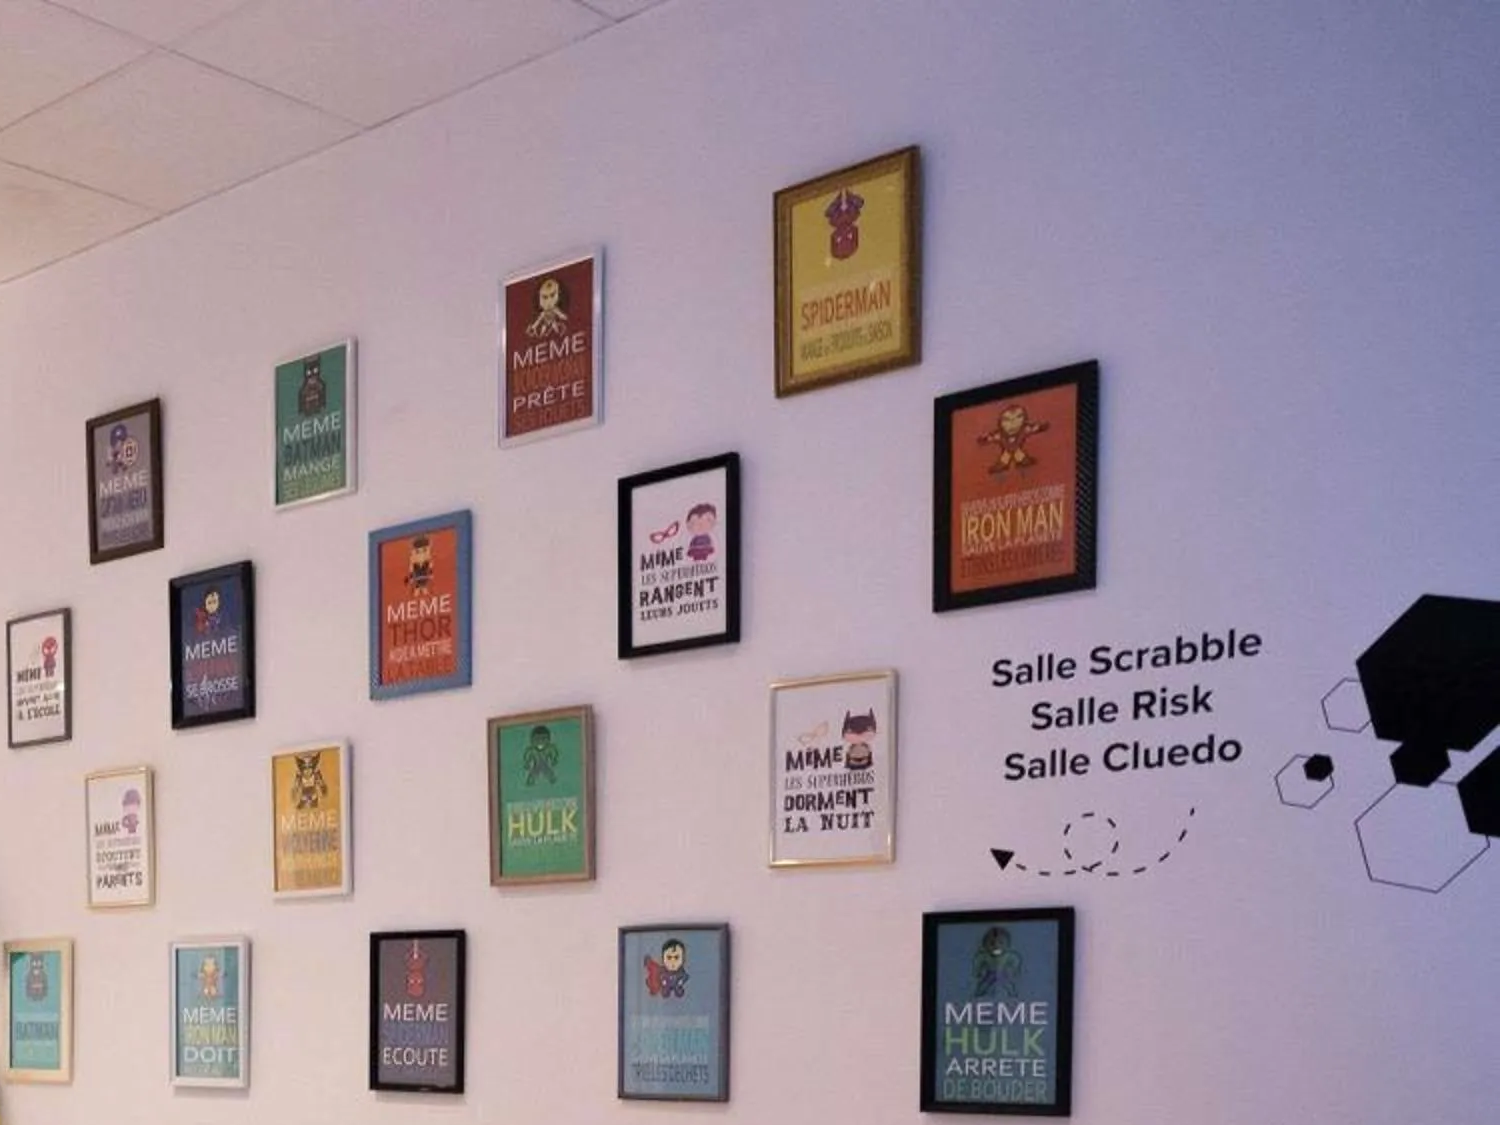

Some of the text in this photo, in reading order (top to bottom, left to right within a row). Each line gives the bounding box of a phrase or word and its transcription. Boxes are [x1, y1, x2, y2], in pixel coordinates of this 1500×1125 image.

[801, 280, 892, 331] SPIDERMAN
[512, 332, 587, 369] MEME
[512, 380, 586, 413] PRÊTE
[283, 411, 342, 445] MEME
[99, 470, 150, 499] MEME
[961, 509, 1011, 551] IRON
[1018, 498, 1064, 537] MAN
[639, 576, 719, 608] RANGENT
[387, 594, 453, 623] MEME
[677, 598, 719, 616] JOUETS
[389, 616, 453, 647] THOR
[185, 635, 239, 661] MEME
[991, 628, 1263, 687] Salle Scrabble
[1031, 685, 1214, 730] Salle Risk
[1004, 734, 1243, 781] Salle Cluedo
[783, 788, 875, 812] DORMENT
[281, 809, 337, 835] MEME
[508, 806, 578, 841] HULK
[784, 811, 875, 833] LA NUIT
[183, 1006, 237, 1024] MEME
[383, 1003, 449, 1022] MEME
[945, 1002, 1049, 1025] MEME
[184, 1046, 237, 1064] DOIT
[945, 1026, 1045, 1057] HULK
[383, 1046, 449, 1067] ECOUTE
[946, 1057, 1047, 1078] ARRETE
[943, 1079, 1048, 1102] DE BOUDER
